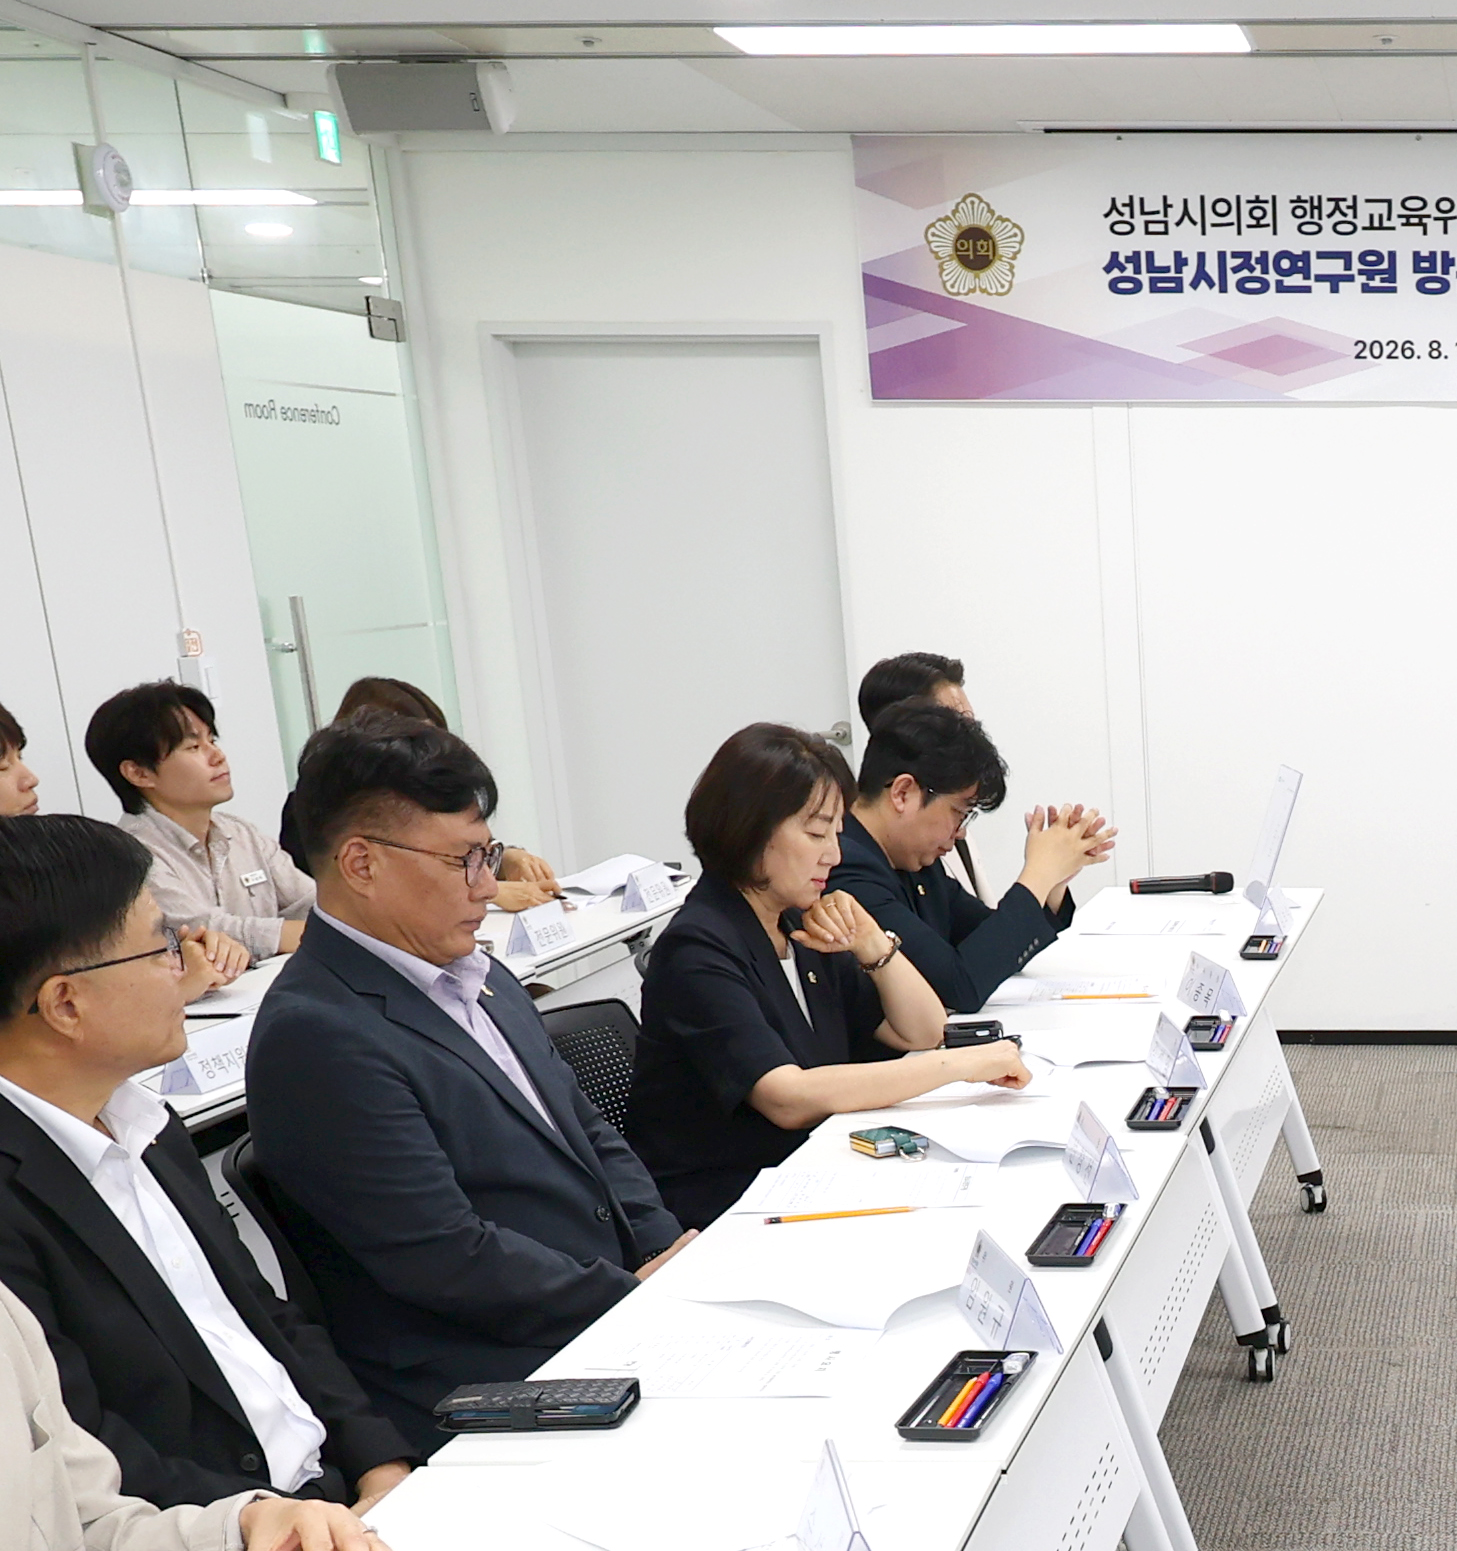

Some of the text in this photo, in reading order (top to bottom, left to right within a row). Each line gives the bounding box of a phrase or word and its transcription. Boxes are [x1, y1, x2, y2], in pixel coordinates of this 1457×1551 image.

[1102, 194, 1278, 237] 성남시의회
[954, 237, 997, 264] 의회
[1102, 249, 1398, 296] 성남시정연구원
[1353, 339, 1421, 360] 2026.
[1428, 340, 1448, 360] 8.
